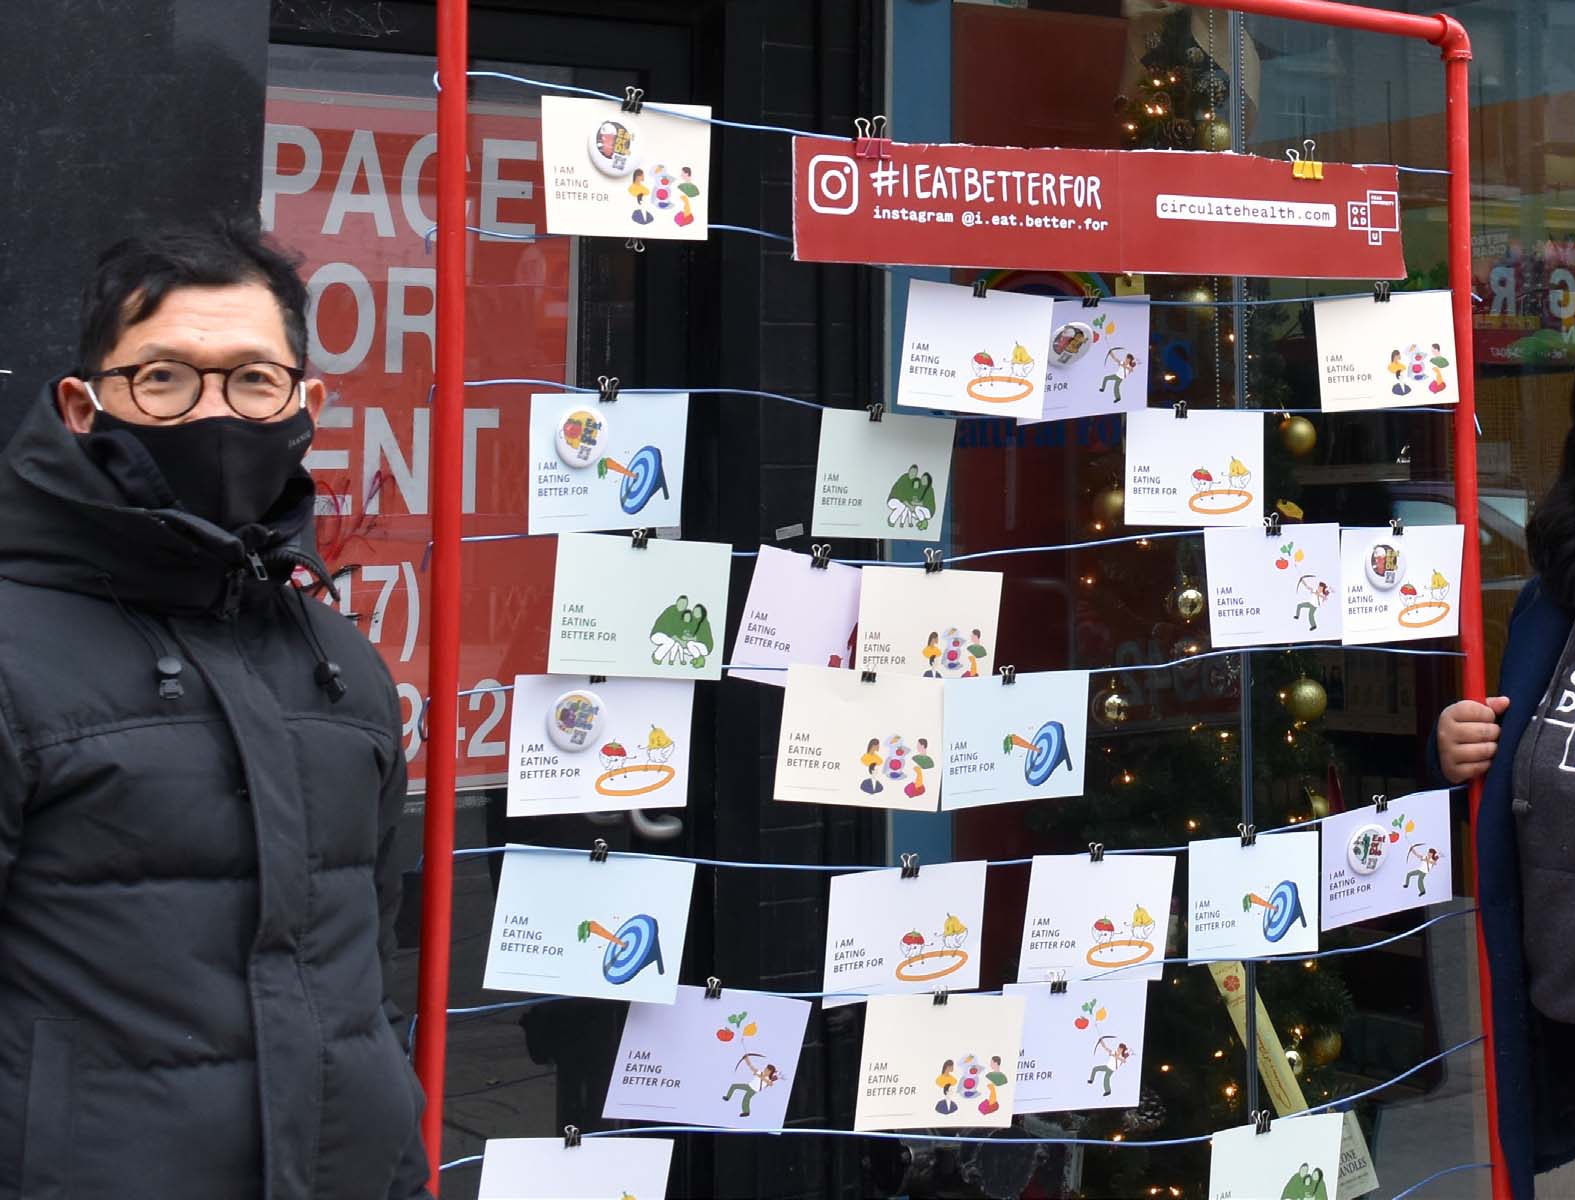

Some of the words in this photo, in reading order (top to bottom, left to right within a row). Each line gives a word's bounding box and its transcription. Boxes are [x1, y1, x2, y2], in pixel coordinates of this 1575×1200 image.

[261, 123, 537, 243] PACE
[1160, 199, 1330, 221] circulatehealth.com
[873, 205, 954, 223] instagram
[961, 211, 1108, 231] @i.eat.better.for
[1371, 232, 1379, 241] U
[306, 262, 436, 375] OR
[543, 462, 557, 470] AM
[538, 474, 570, 484] EATING
[538, 487, 568, 497] BETTER
[571, 487, 588, 495] FOR
[527, 744, 544, 753] AM
[520, 756, 558, 766] EATING
[520, 770, 557, 780] BETTER
[559, 768, 581, 777] FOR
[511, 916, 528, 926] AM
[503, 929, 542, 941] EATING
[501, 942, 539, 954] BETTER
[542, 945, 564, 956] FOR
[634, 1051, 651, 1060] AM
[625, 1063, 662, 1074] EATING
[622, 1076, 659, 1087] BETTER
[661, 1077, 681, 1088] FOR
